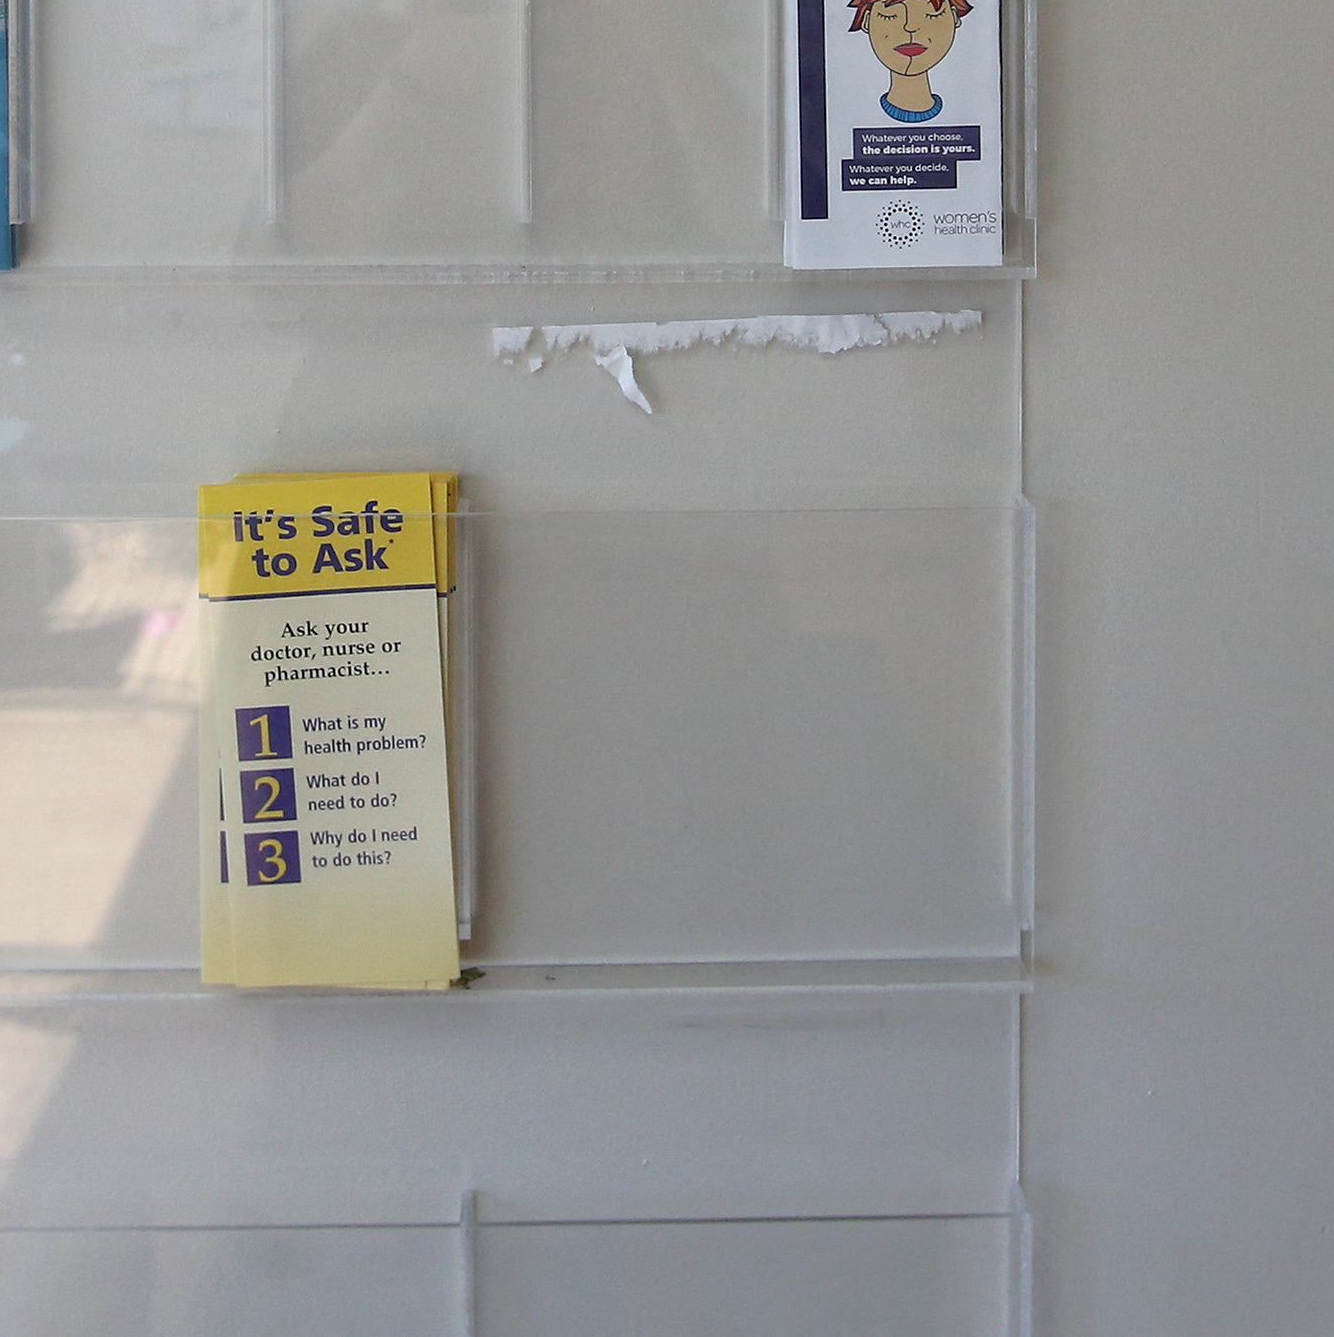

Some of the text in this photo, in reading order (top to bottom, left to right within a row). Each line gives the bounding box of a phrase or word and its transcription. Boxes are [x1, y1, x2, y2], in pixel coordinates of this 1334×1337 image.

[862, 134, 907, 143] Whatever
[908, 135, 926, 144] you
[862, 144, 975, 156] the decision is yours.
[849, 164, 894, 173] Whatever
[895, 165, 913, 174] you
[849, 175, 917, 187] we can help.
[933, 210, 997, 224] women's
[233, 501, 404, 542] It's Safe
[252, 548, 297, 577] to
[281, 621, 369, 640] Ask your
[251, 642, 401, 662] doctor, nurse or
[264, 661, 390, 686] pharmacist...
[302, 715, 386, 732] What is my
[249, 714, 278, 757] 1
[304, 735, 427, 754] health problem?
[306, 772, 380, 789] What do I
[254, 776, 284, 819] 2
[308, 793, 397, 811] need to do?
[310, 827, 417, 847] Why do I need
[258, 838, 287, 882] 3
[312, 850, 392, 868] to do this?
